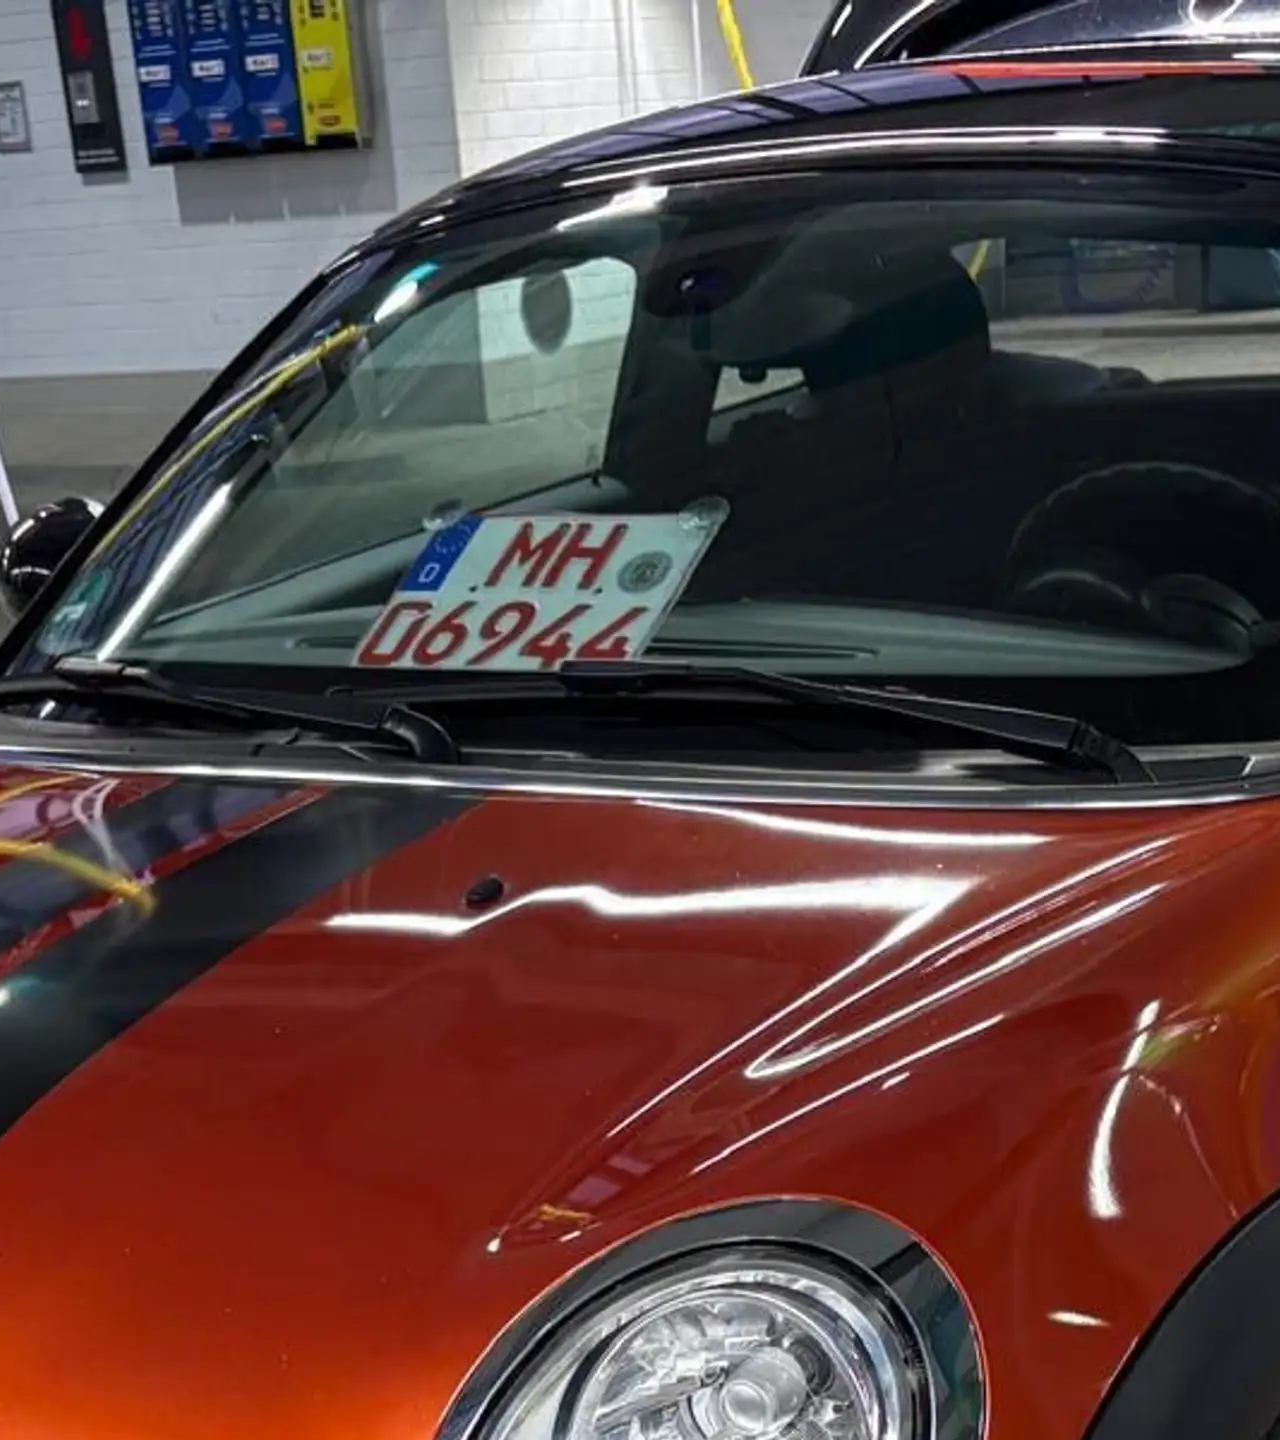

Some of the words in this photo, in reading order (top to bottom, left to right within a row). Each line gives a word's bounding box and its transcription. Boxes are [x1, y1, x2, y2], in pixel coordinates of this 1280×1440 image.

[417, 562, 441, 584] D
[483, 520, 629, 590] MH
[357, 600, 650, 671] 06944
